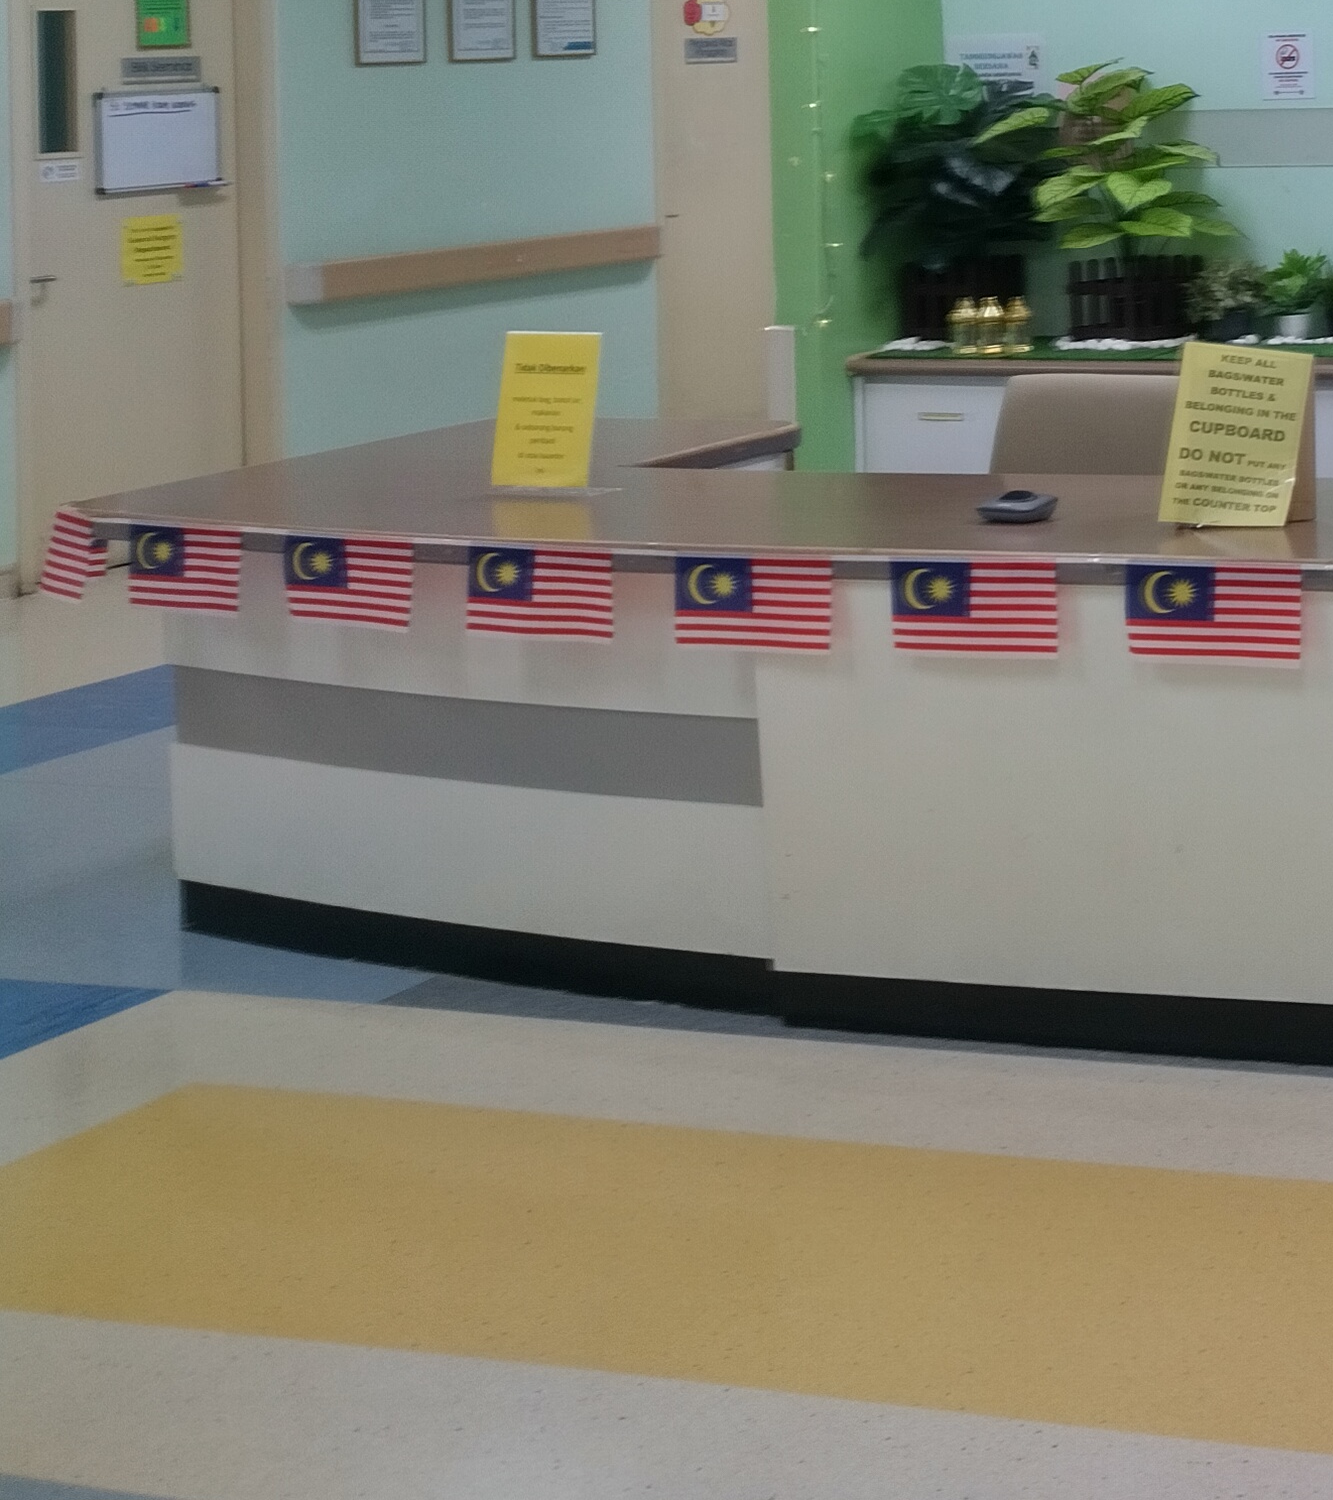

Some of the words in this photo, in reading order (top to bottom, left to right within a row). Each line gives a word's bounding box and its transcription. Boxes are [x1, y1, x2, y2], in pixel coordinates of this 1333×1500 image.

[1221, 354, 1252, 365] KEEP
[1254, 359, 1277, 369] ALL
[1210, 386, 1264, 400] BOTTLES
[1267, 393, 1276, 401] &
[1185, 400, 1254, 416] BELONGING
[1257, 409, 1270, 418] IN
[1273, 410, 1297, 421] THE
[1189, 420, 1286, 442] CUPBOARD
[1179, 447, 1203, 461] DO
[1208, 450, 1246, 465] NOT
[1192, 497, 1251, 512] COUNTER
[1253, 503, 1277, 513] TOP
